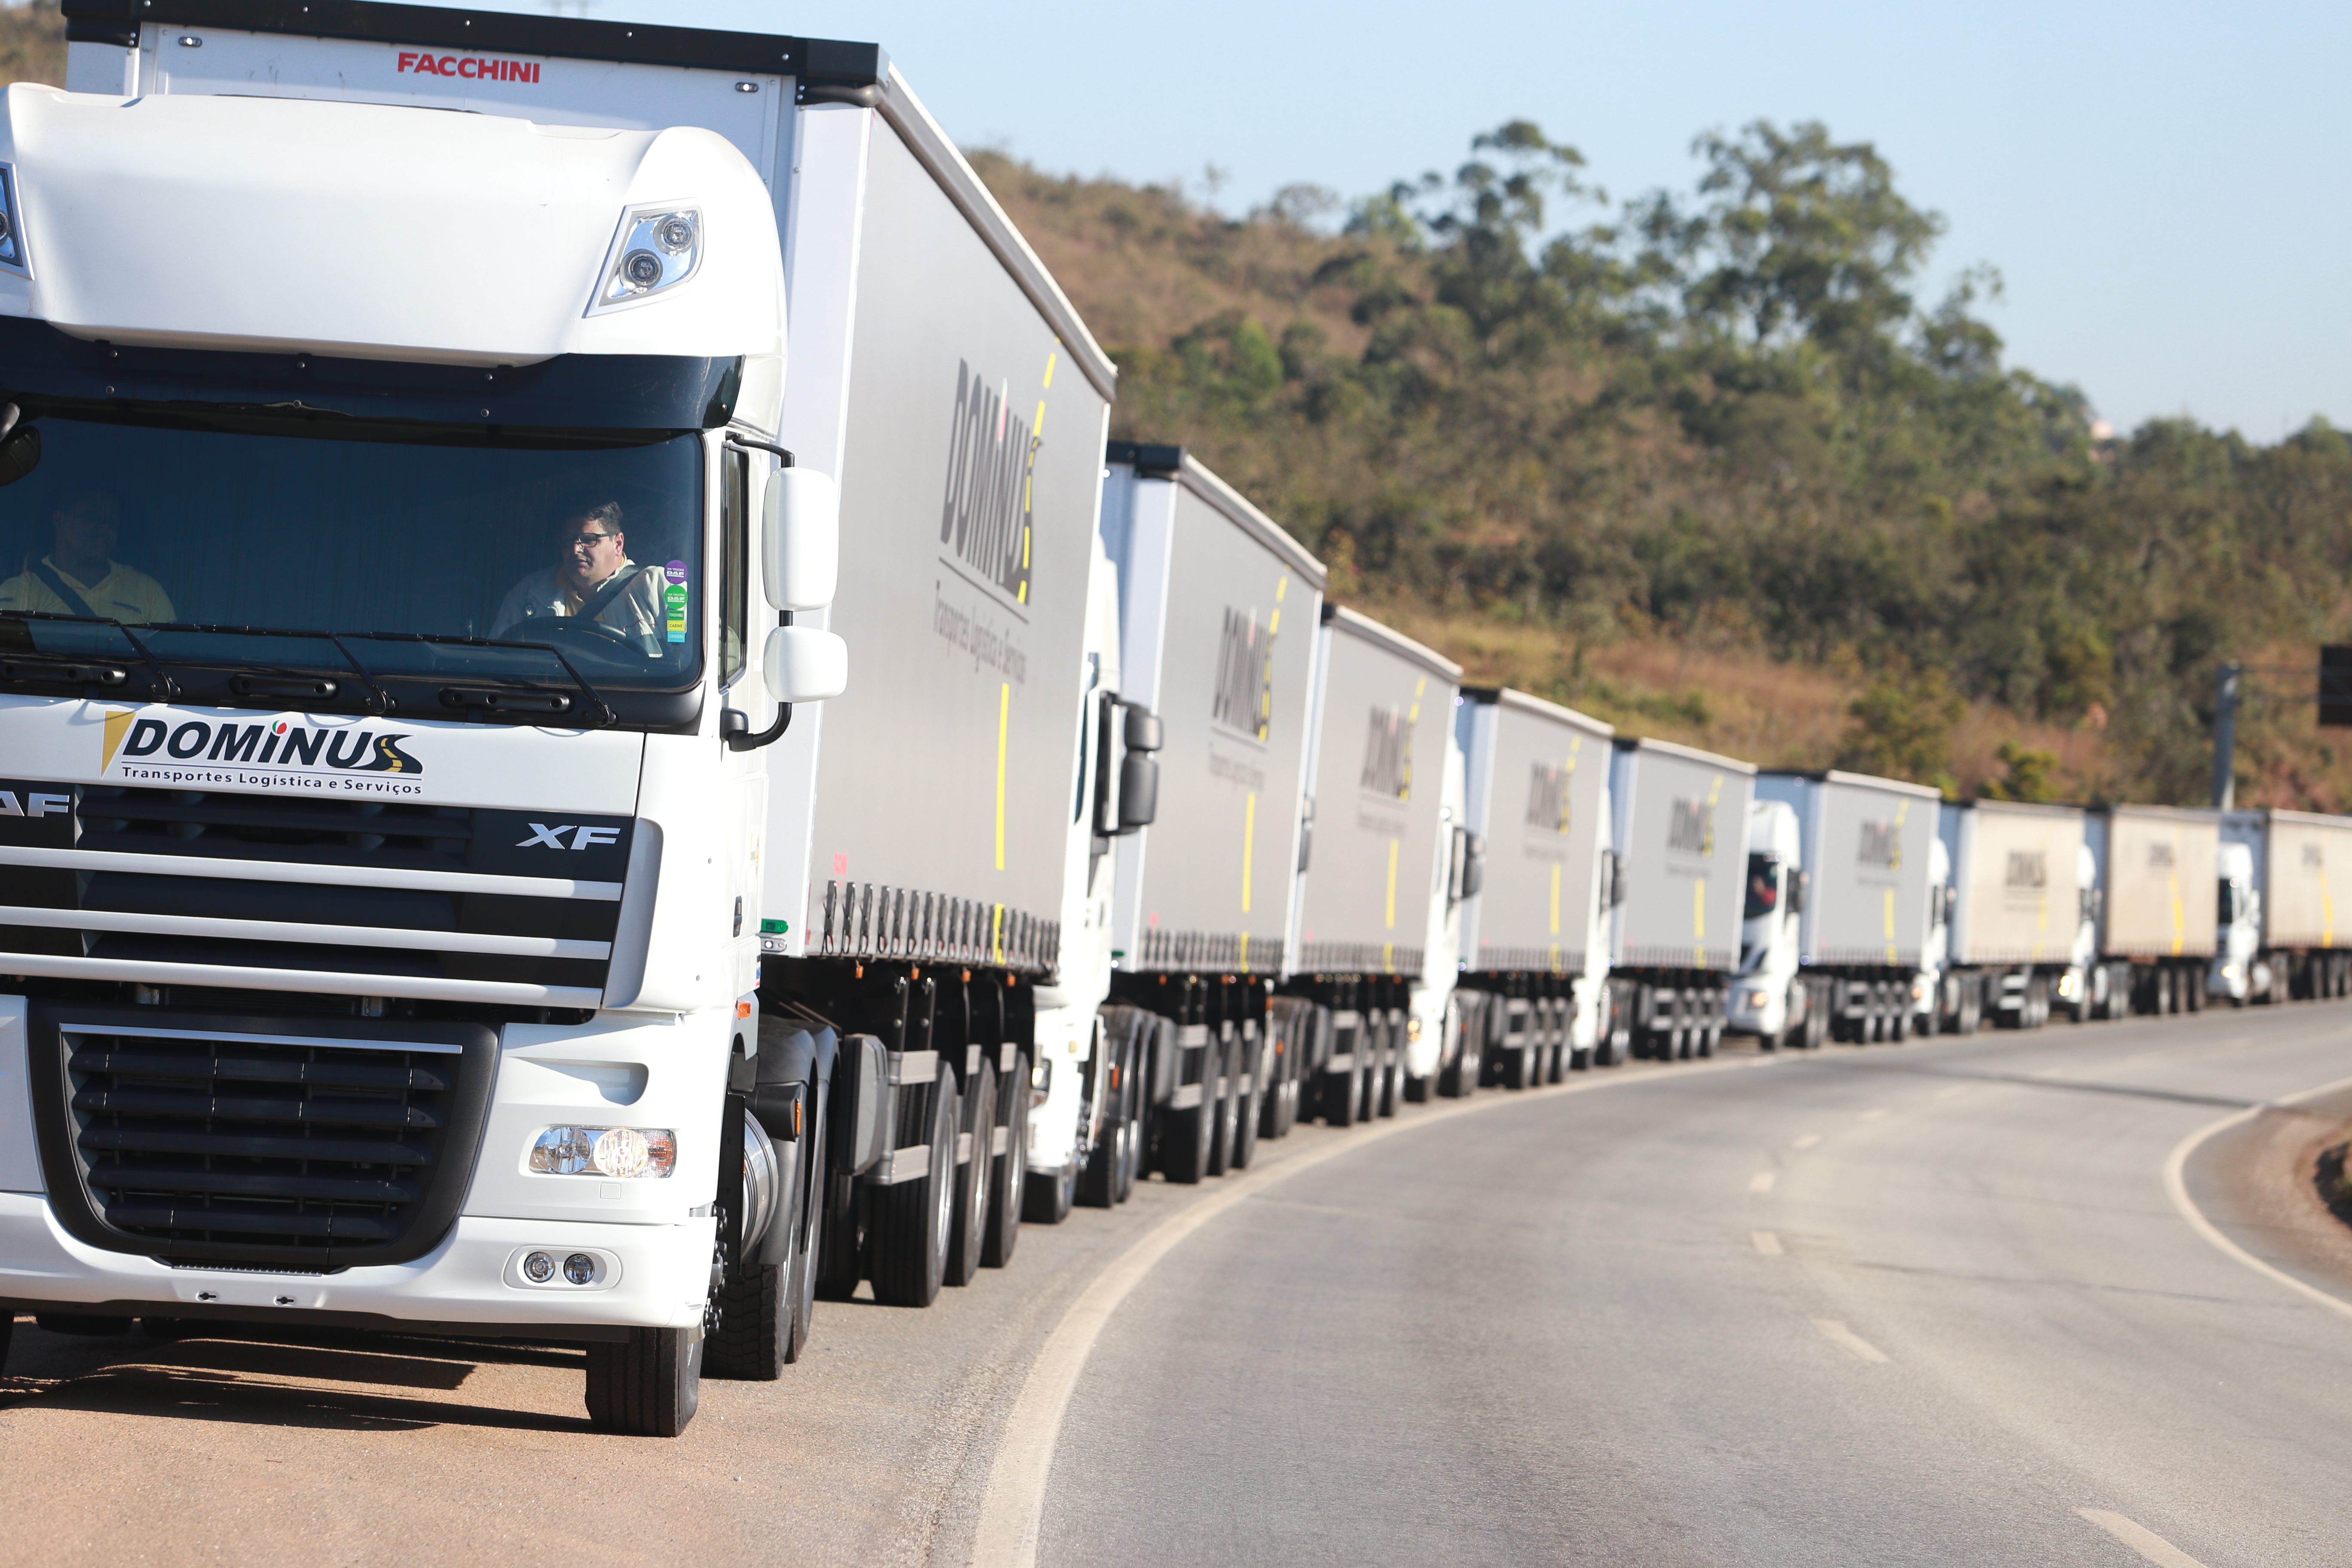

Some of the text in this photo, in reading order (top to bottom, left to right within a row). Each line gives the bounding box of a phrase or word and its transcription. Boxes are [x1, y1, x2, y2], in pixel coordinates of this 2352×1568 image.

[398, 52, 540, 83] FACCHINI
[122, 767, 232, 782] Transportes
[239, 773, 322, 787] Logística
[344, 779, 422, 795] Serviços
[515, 823, 621, 850] XF
